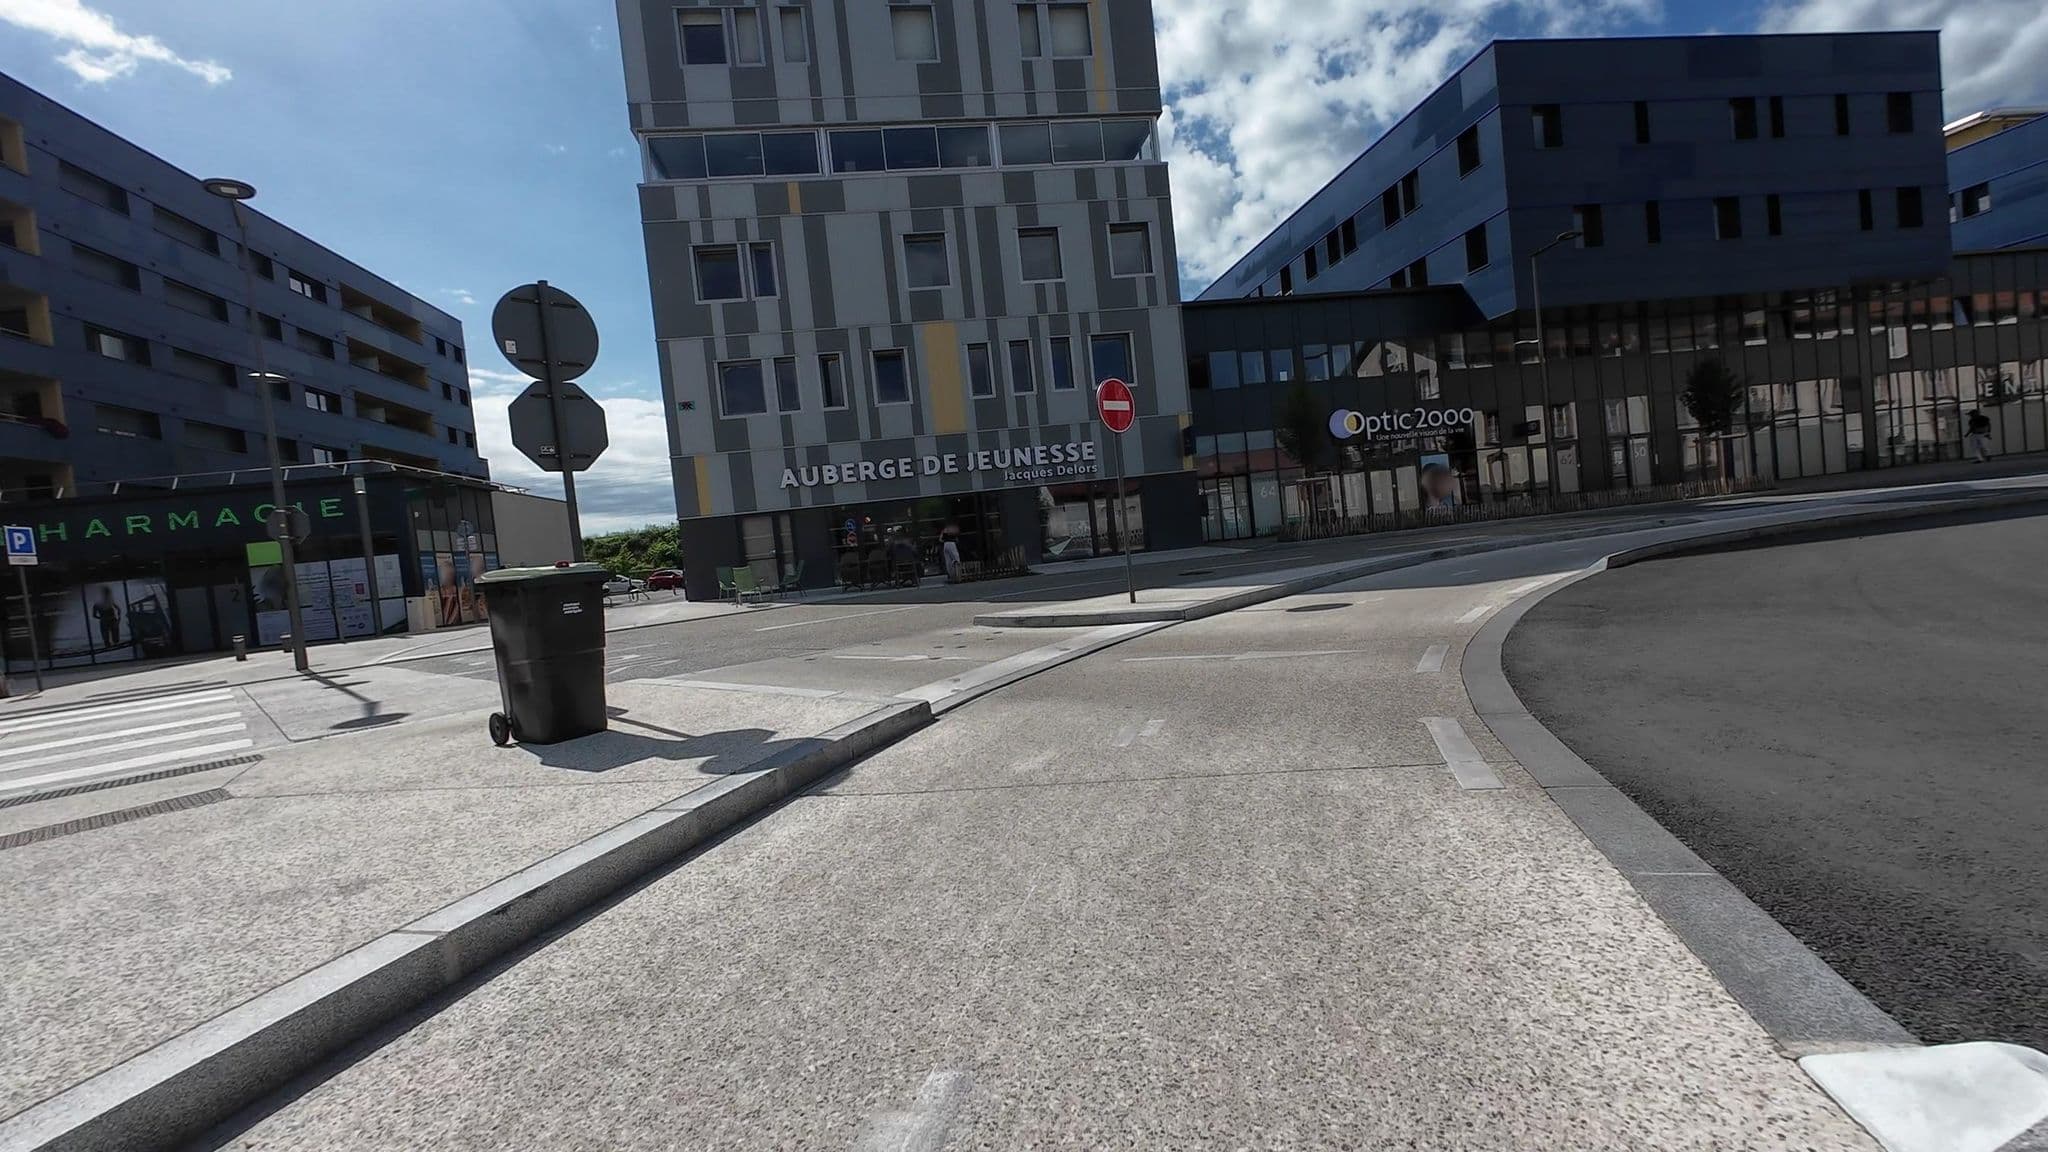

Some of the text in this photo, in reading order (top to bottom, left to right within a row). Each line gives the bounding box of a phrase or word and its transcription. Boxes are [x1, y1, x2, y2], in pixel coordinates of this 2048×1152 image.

[1344, 407, 1474, 440] Optic 2000
[780, 441, 1097, 489] AUBERGE DE JEUNESSE
[1004, 463, 1098, 481] Jacques Delors
[13, 532, 27, 550] P
